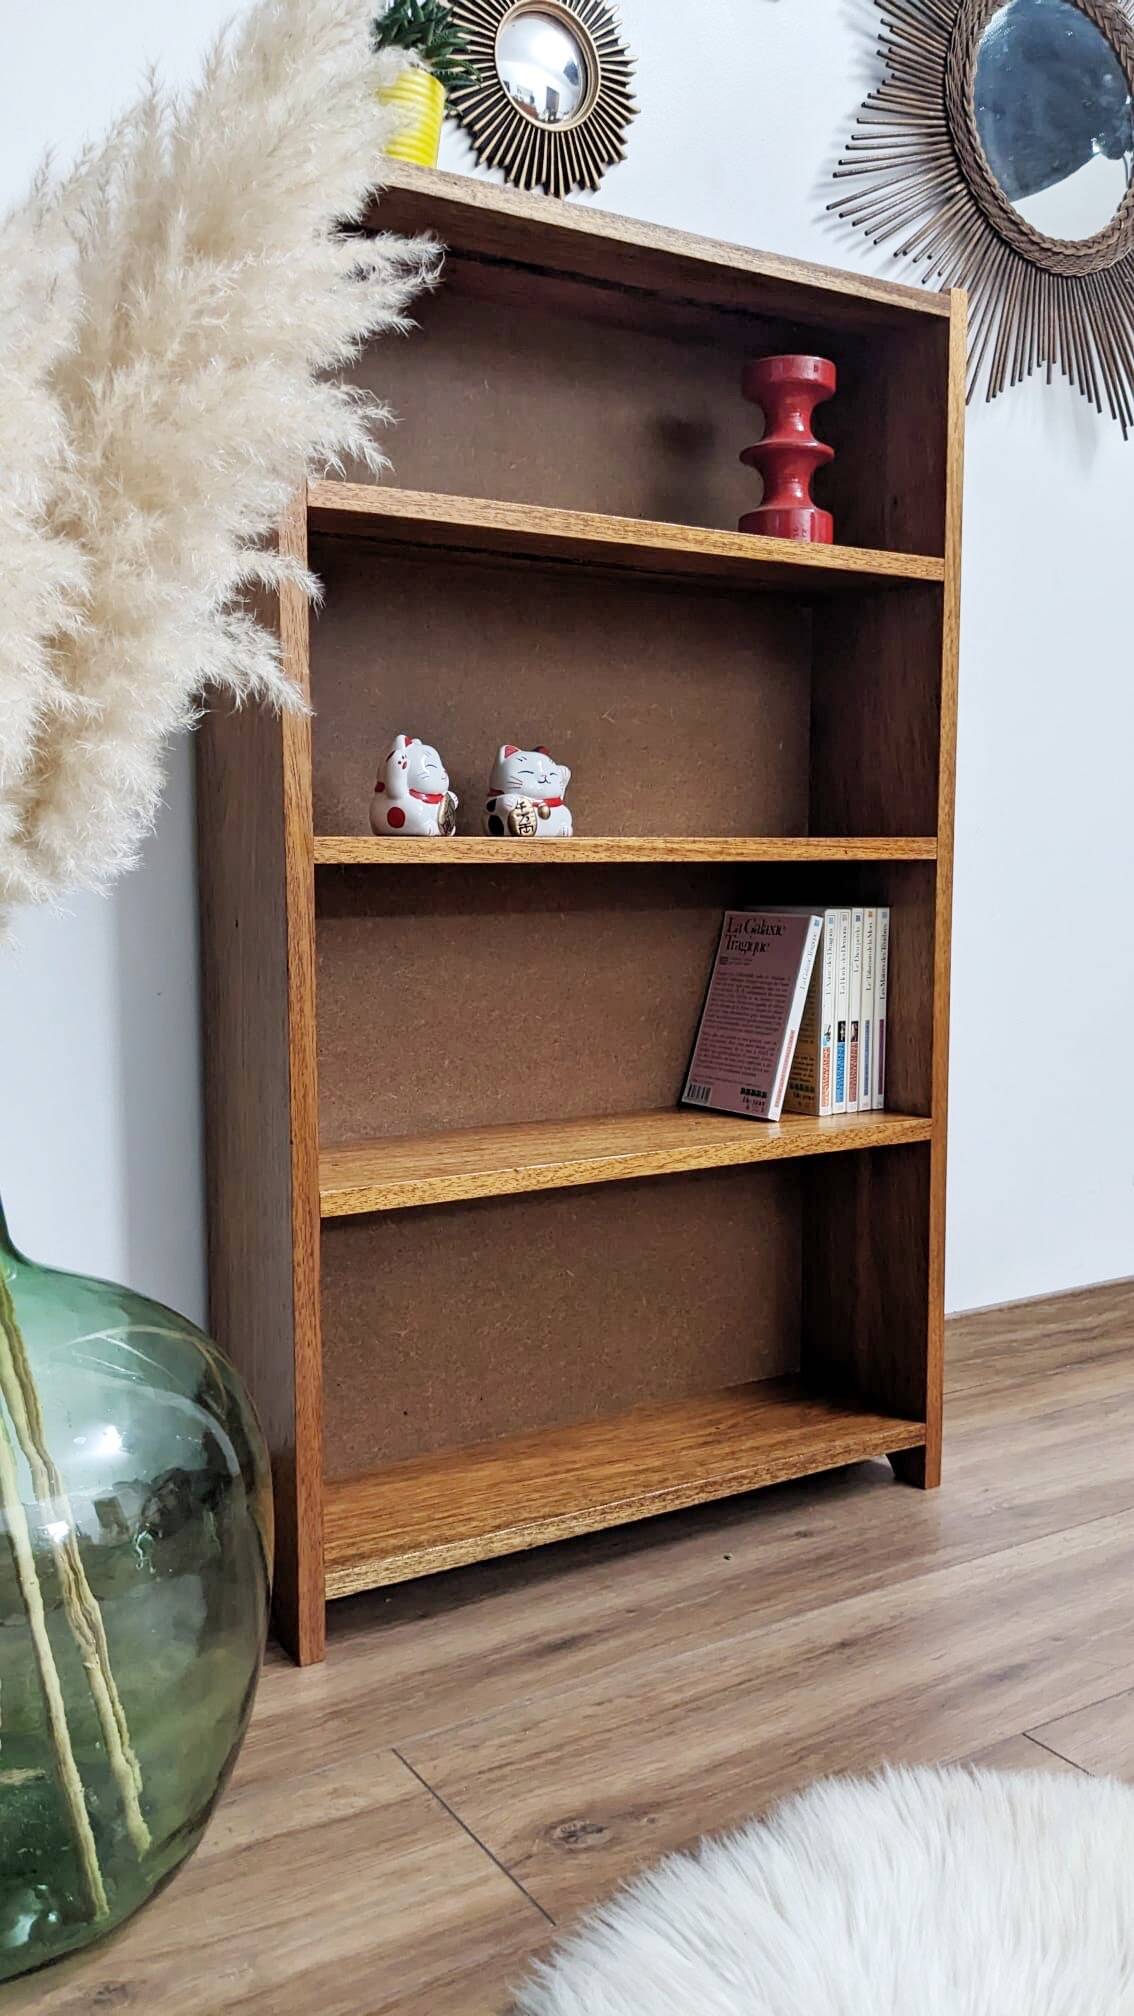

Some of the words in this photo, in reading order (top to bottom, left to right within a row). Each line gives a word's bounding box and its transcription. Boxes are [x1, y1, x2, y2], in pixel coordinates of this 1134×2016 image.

[727, 917, 743, 934] La
[745, 918, 788, 936] Galaxie
[725, 934, 771, 956] Tragique
